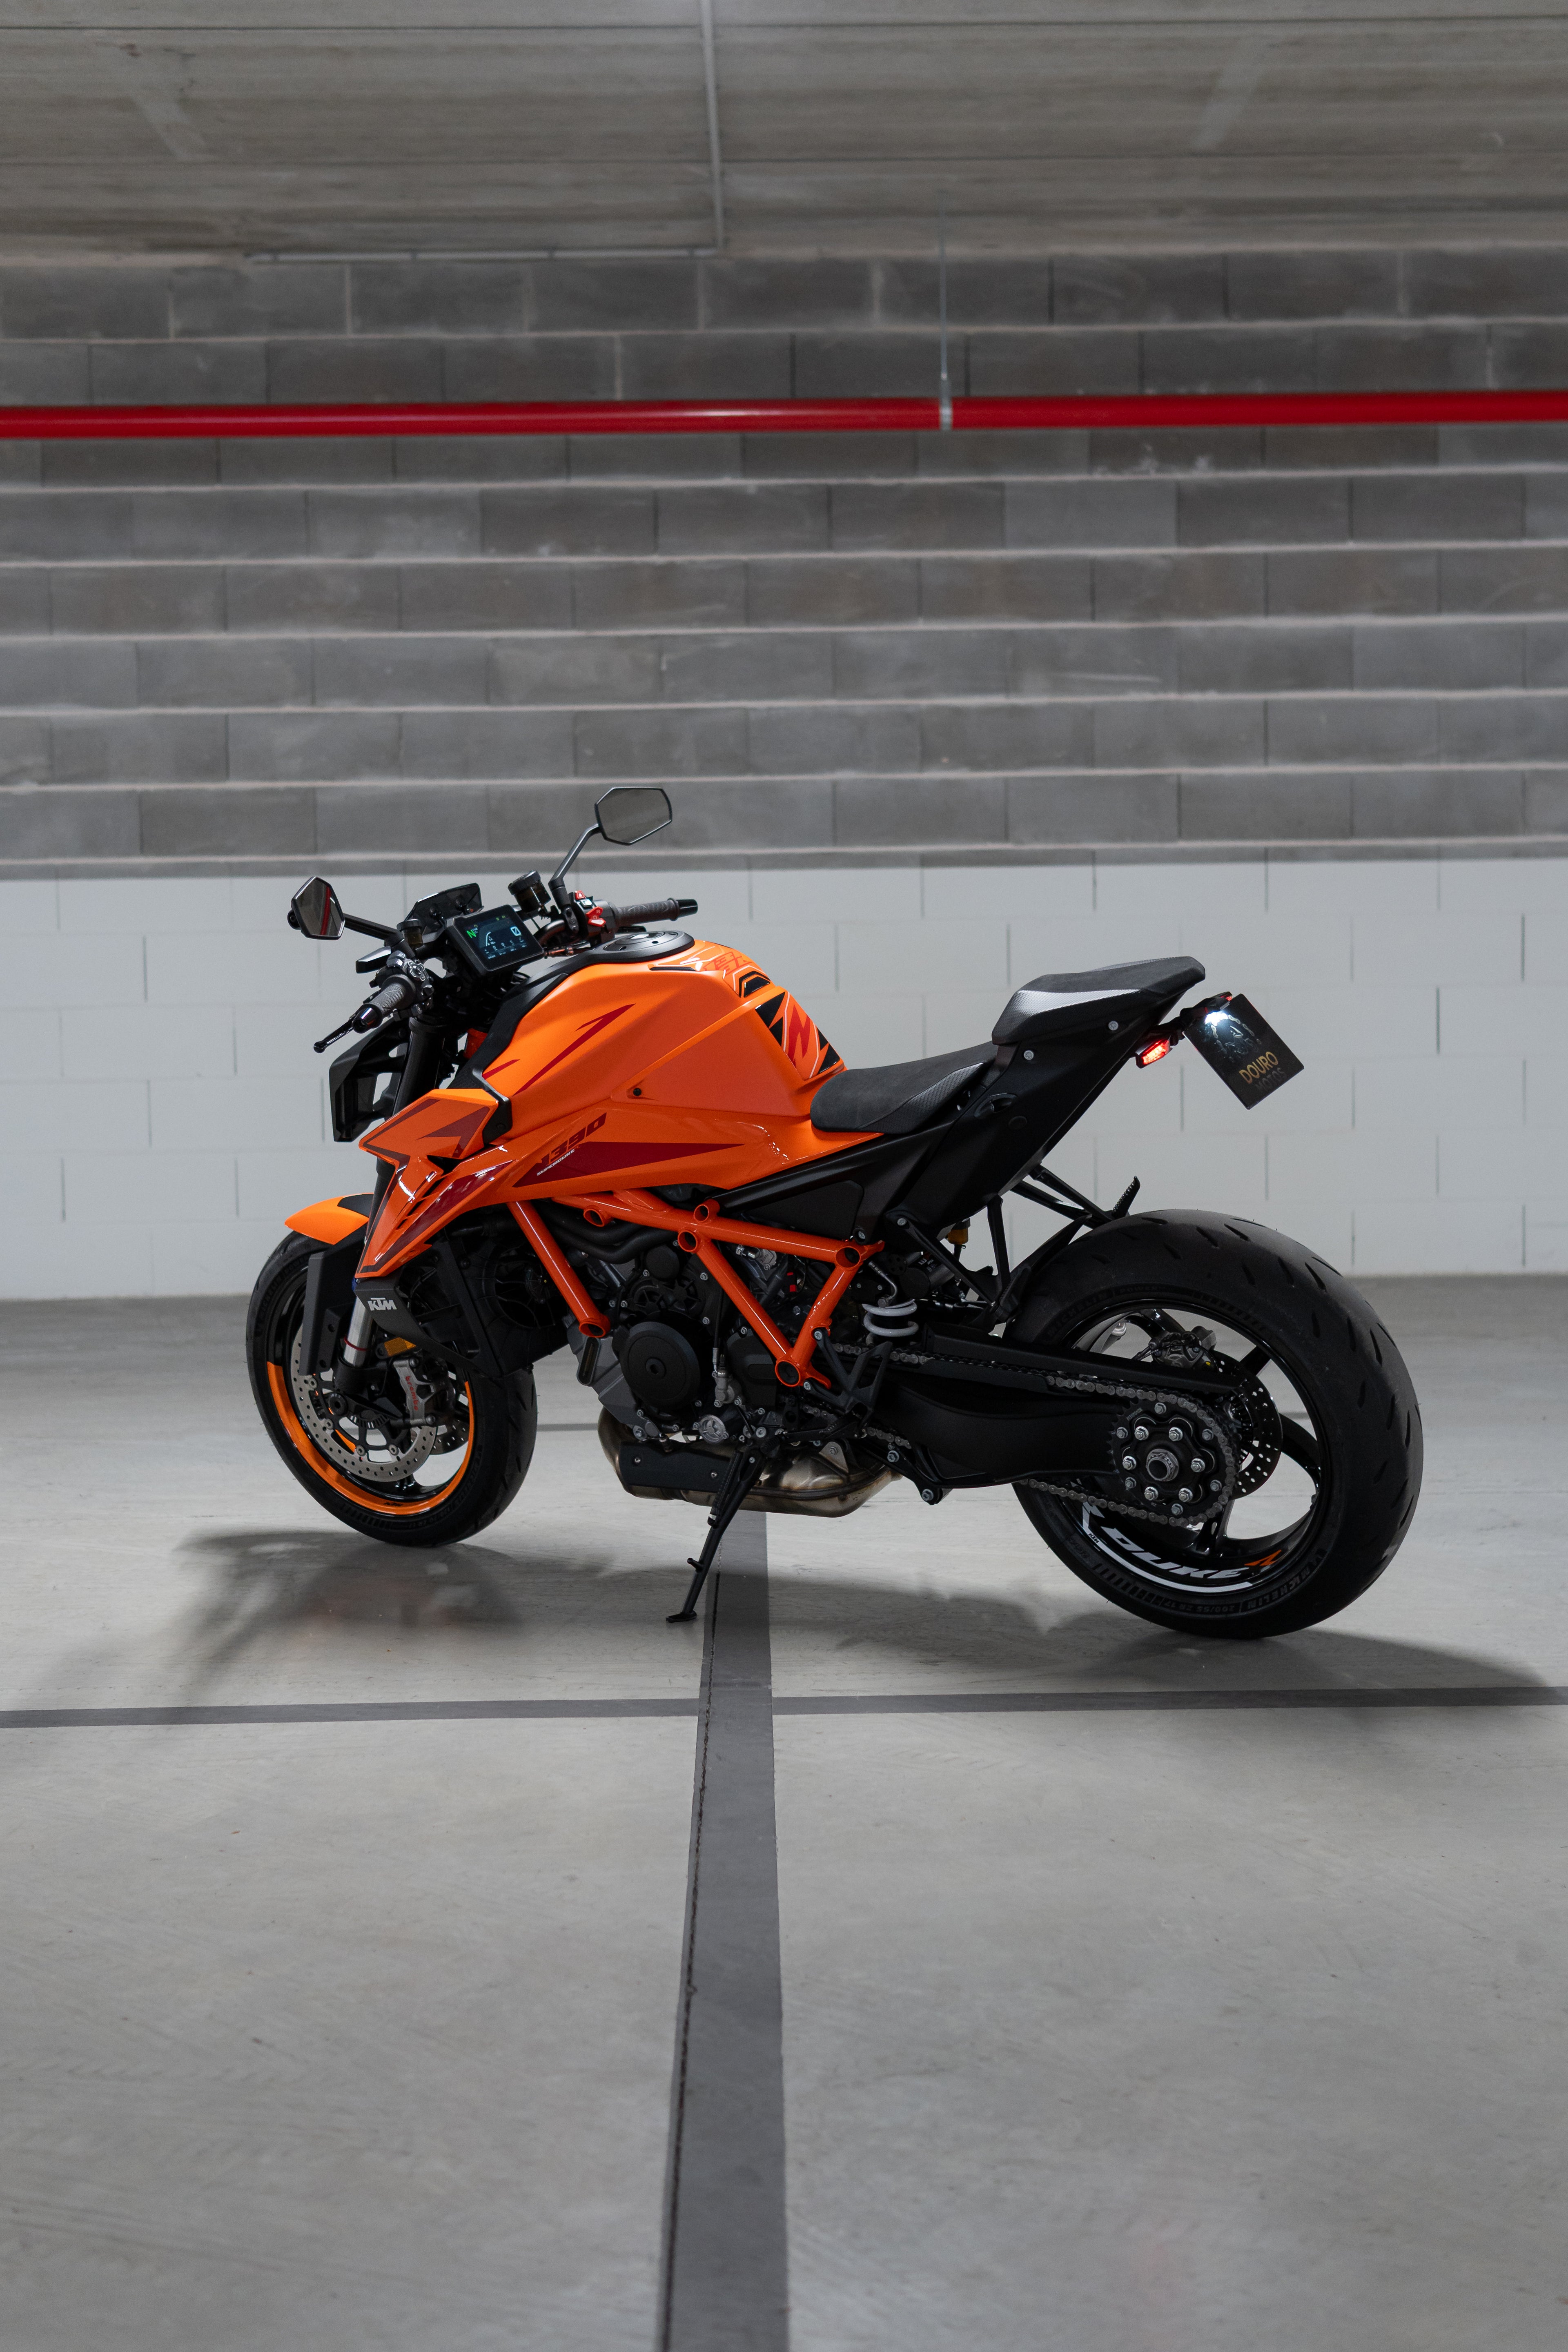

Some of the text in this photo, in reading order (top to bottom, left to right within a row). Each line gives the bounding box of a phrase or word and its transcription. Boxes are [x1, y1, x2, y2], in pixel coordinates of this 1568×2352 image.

[466, 929, 477, 938] N
[1238, 1051, 1278, 1084] DOURO
[1255, 1067, 1287, 1091] MOTOS
[541, 1112, 607, 1168] 1390
[537, 1148, 575, 1176] SUPERDUKE
[367, 1297, 398, 1311] KTM
[1047, 1292, 1107, 1336] MICHELIN
[405, 1376, 419, 1411] brembo
[1088, 1533, 1100, 1544] KTM
[1100, 1526, 1251, 1579] DUKE
[1247, 1566, 1310, 1610] MICHELIN
[1164, 1600, 1177, 1609] 17
[1197, 1604, 1235, 1613] 200/55
